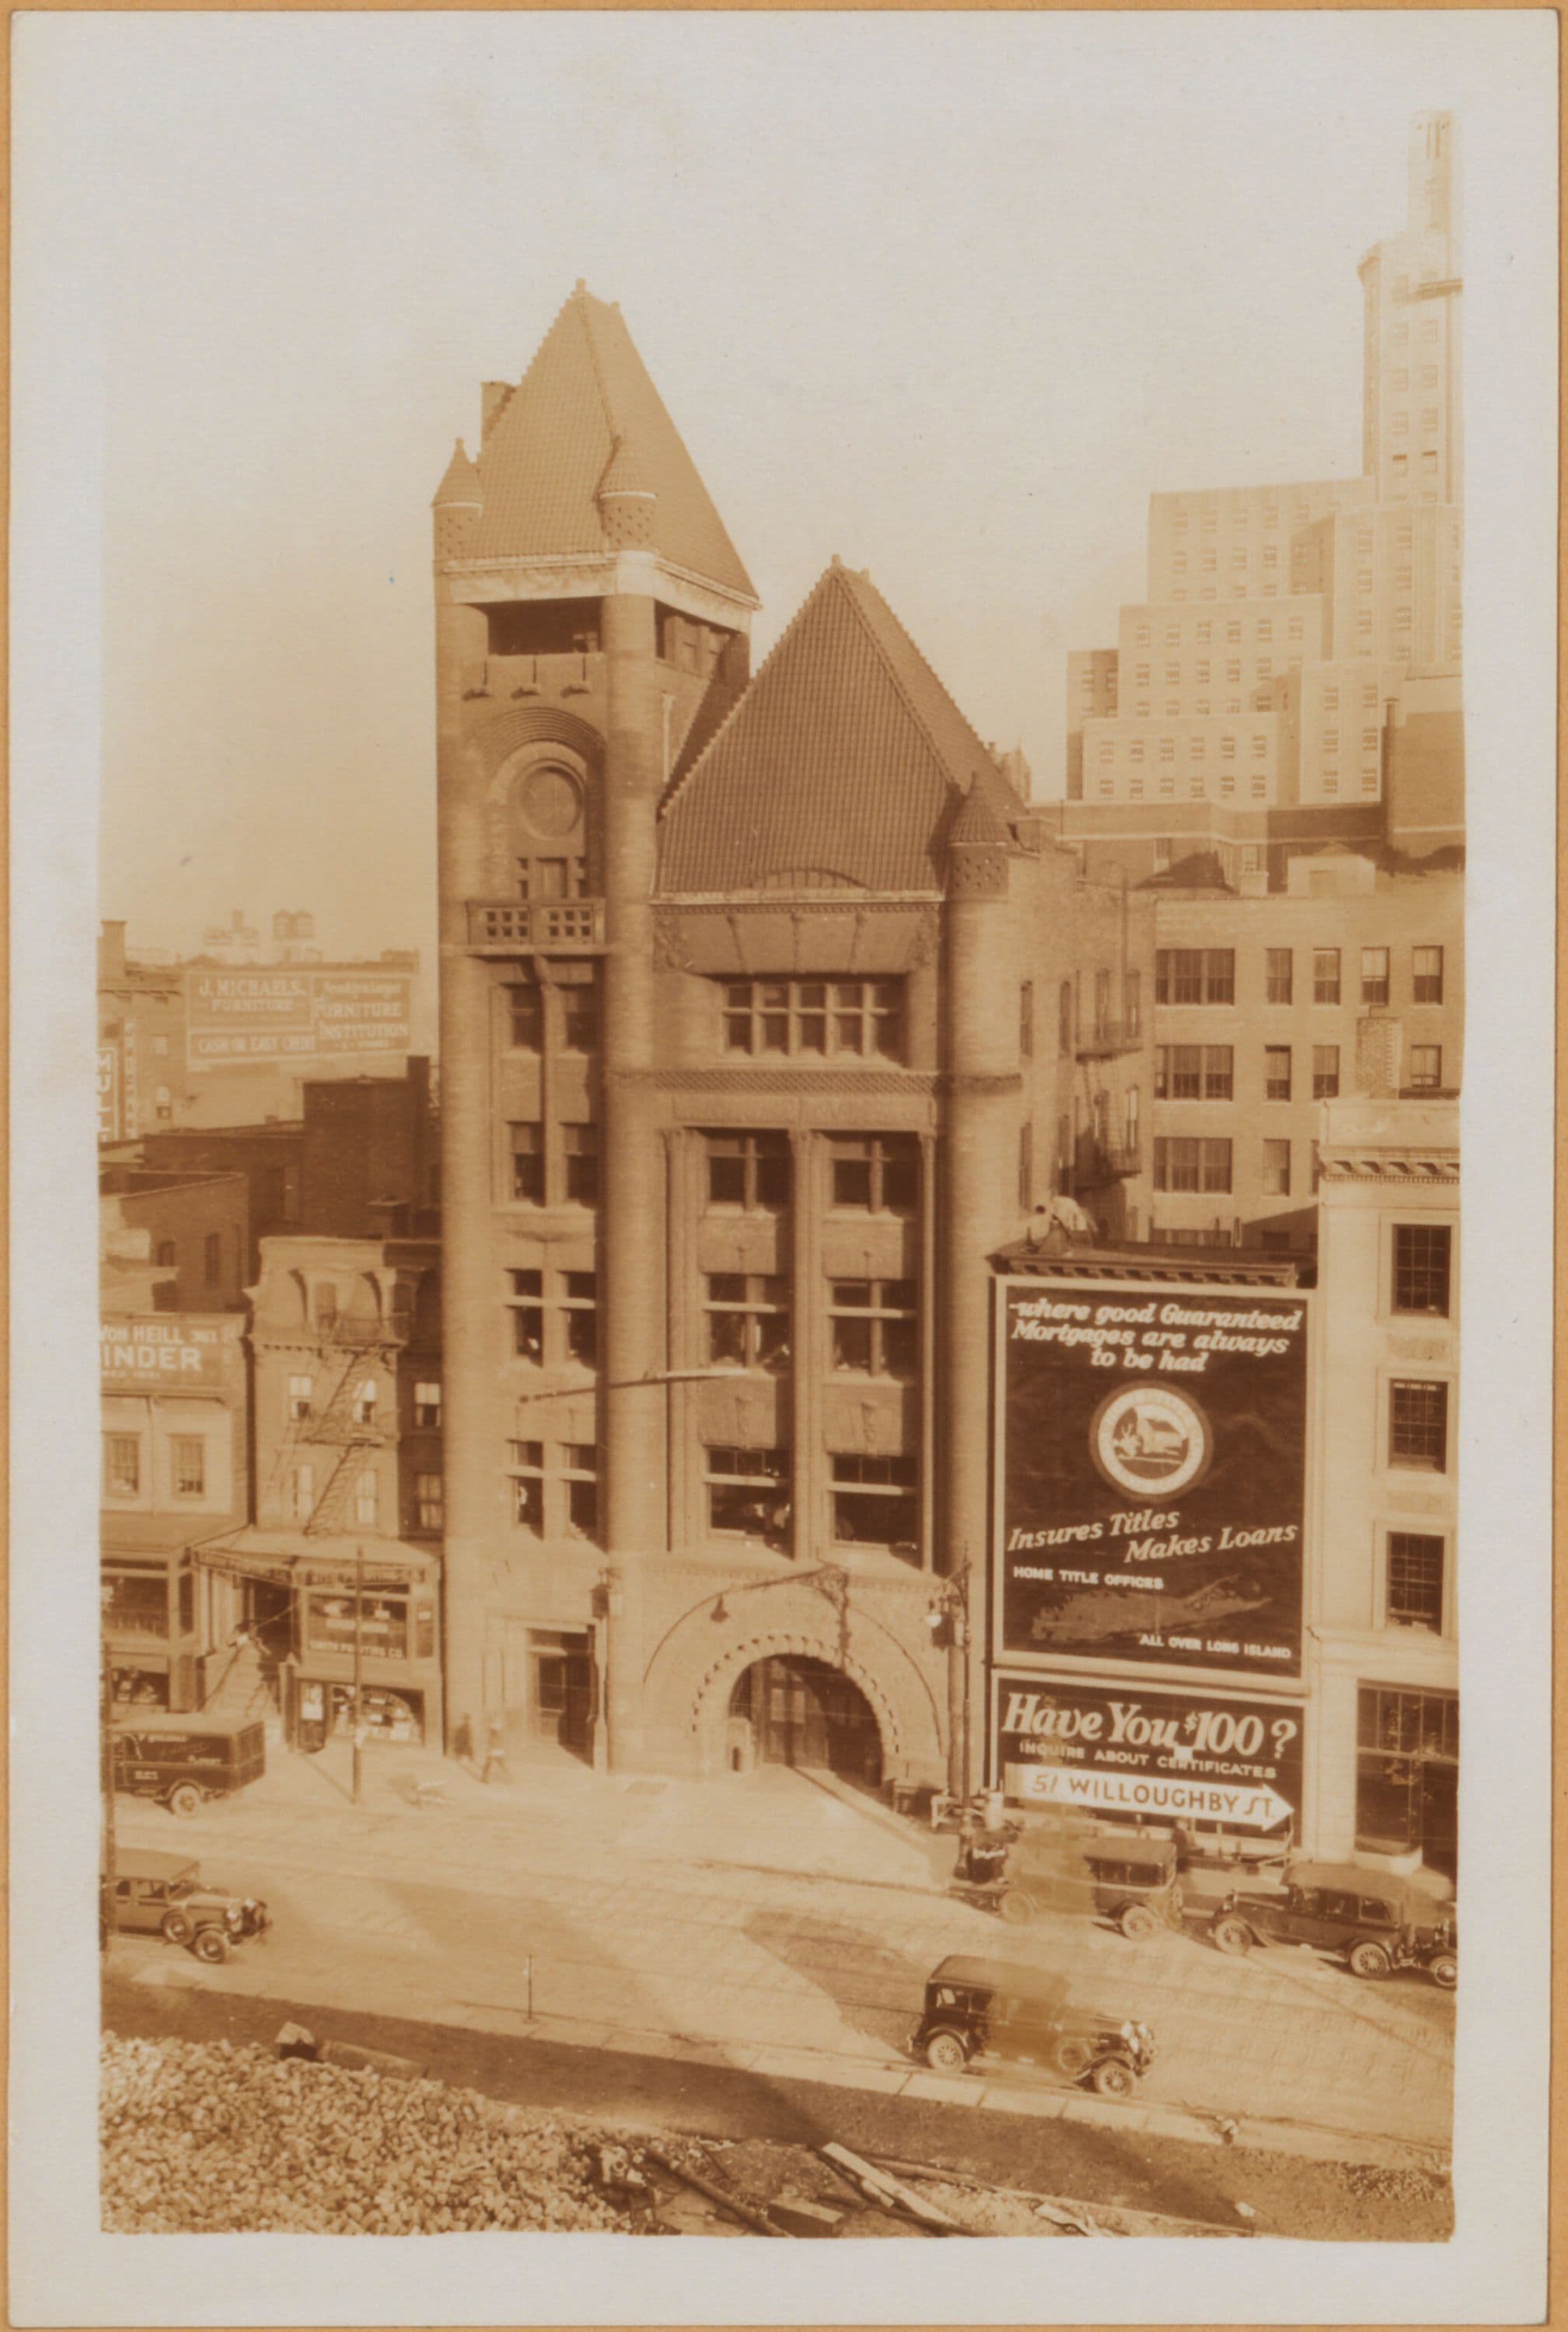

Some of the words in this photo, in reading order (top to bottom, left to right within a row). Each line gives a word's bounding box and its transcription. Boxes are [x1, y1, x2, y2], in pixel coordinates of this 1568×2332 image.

[1095, 1304, 1155, 1325] good
[1160, 1304, 1303, 1332] Guaranteed
[1011, 1319, 1135, 1348] Mortgages
[1142, 1332, 1186, 1348] are
[1193, 1330, 1290, 1357] always
[100, 1345, 201, 1370] INDER
[1091, 1347, 1117, 1367] to
[1123, 1348, 1154, 1369] be
[1158, 1353, 1209, 1372] had
[1008, 1521, 1103, 1551] Insures
[1109, 1509, 1181, 1537] Titles
[1124, 1537, 1211, 1563] Makes
[1217, 1523, 1299, 1551] Loans
[1012, 1566, 1053, 1581] HOME
[1059, 1569, 1098, 1585] TITLE
[1104, 1573, 1165, 1590] OFFICES
[1139, 1633, 1164, 1648] ALL
[1168, 1636, 1202, 1651] OVER
[1207, 1639, 1239, 1654] LONG
[1244, 1642, 1292, 1659] ISLAND
[1001, 1692, 1104, 1743] Have
[1107, 1702, 1179, 1750] You
[1019, 1741, 1085, 1759] INQUIRE
[1095, 1749, 1150, 1766] ABOUT
[1157, 1754, 1277, 1780] CERTIFICATES
[1032, 1773, 1058, 1794] 51
[1068, 1777, 1241, 1814] WILLOUGHBY
